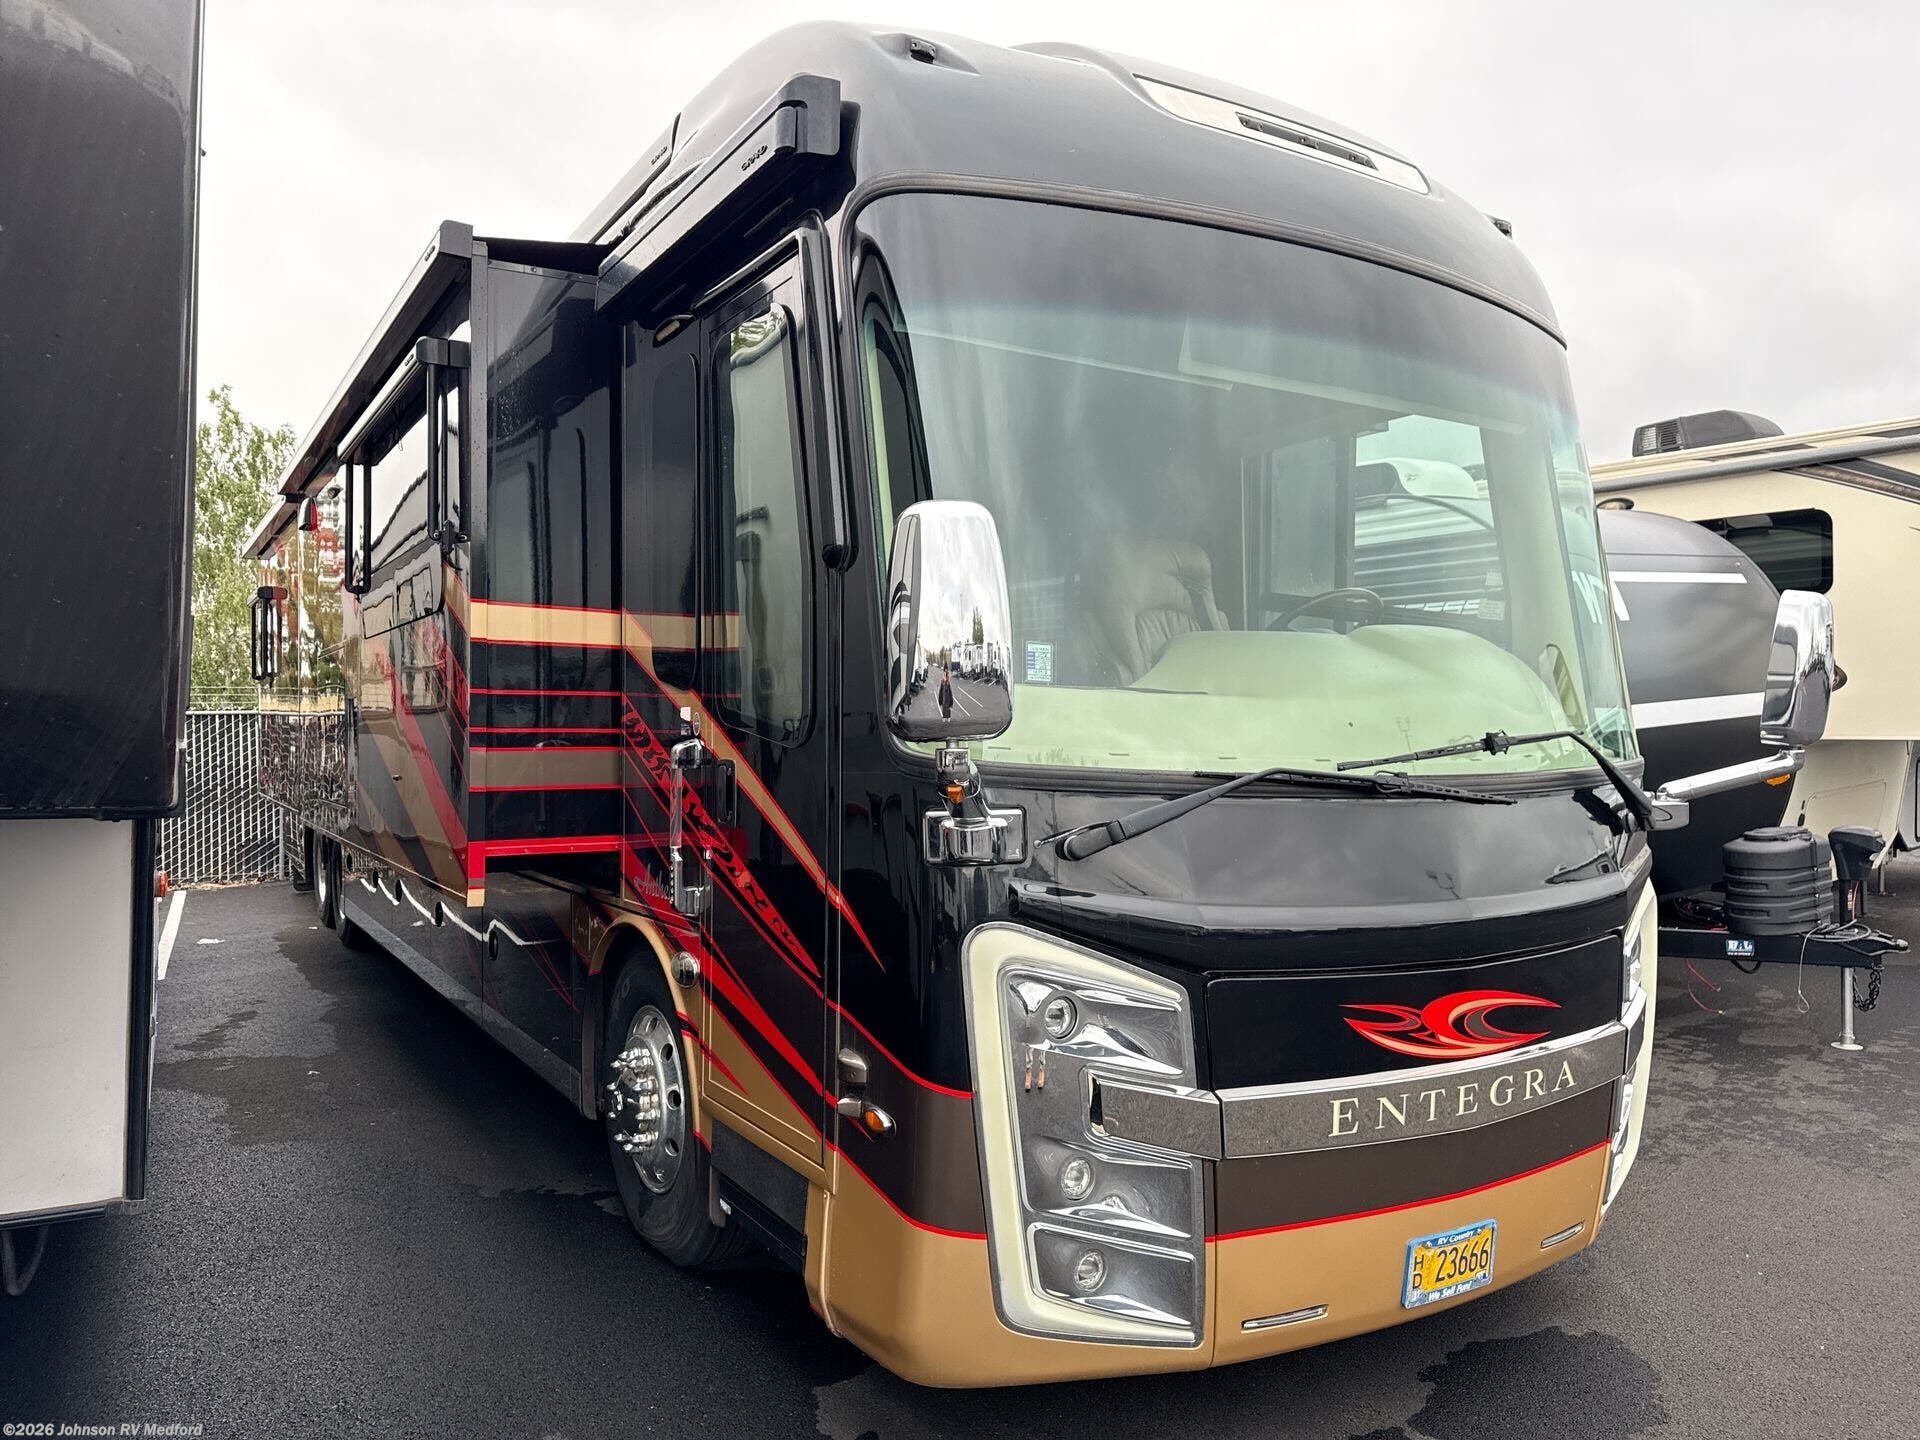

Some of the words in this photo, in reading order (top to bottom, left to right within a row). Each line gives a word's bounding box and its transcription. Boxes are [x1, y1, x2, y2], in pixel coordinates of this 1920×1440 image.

[1328, 1060, 1576, 1137] ENTEGRA
[1437, 1236, 1449, 1246] RV
[1449, 1230, 1475, 1243] Country
[1435, 1237, 1490, 1283] 23666
[1428, 1292, 1441, 1302] We
[1441, 1285, 1455, 1298] Sell
